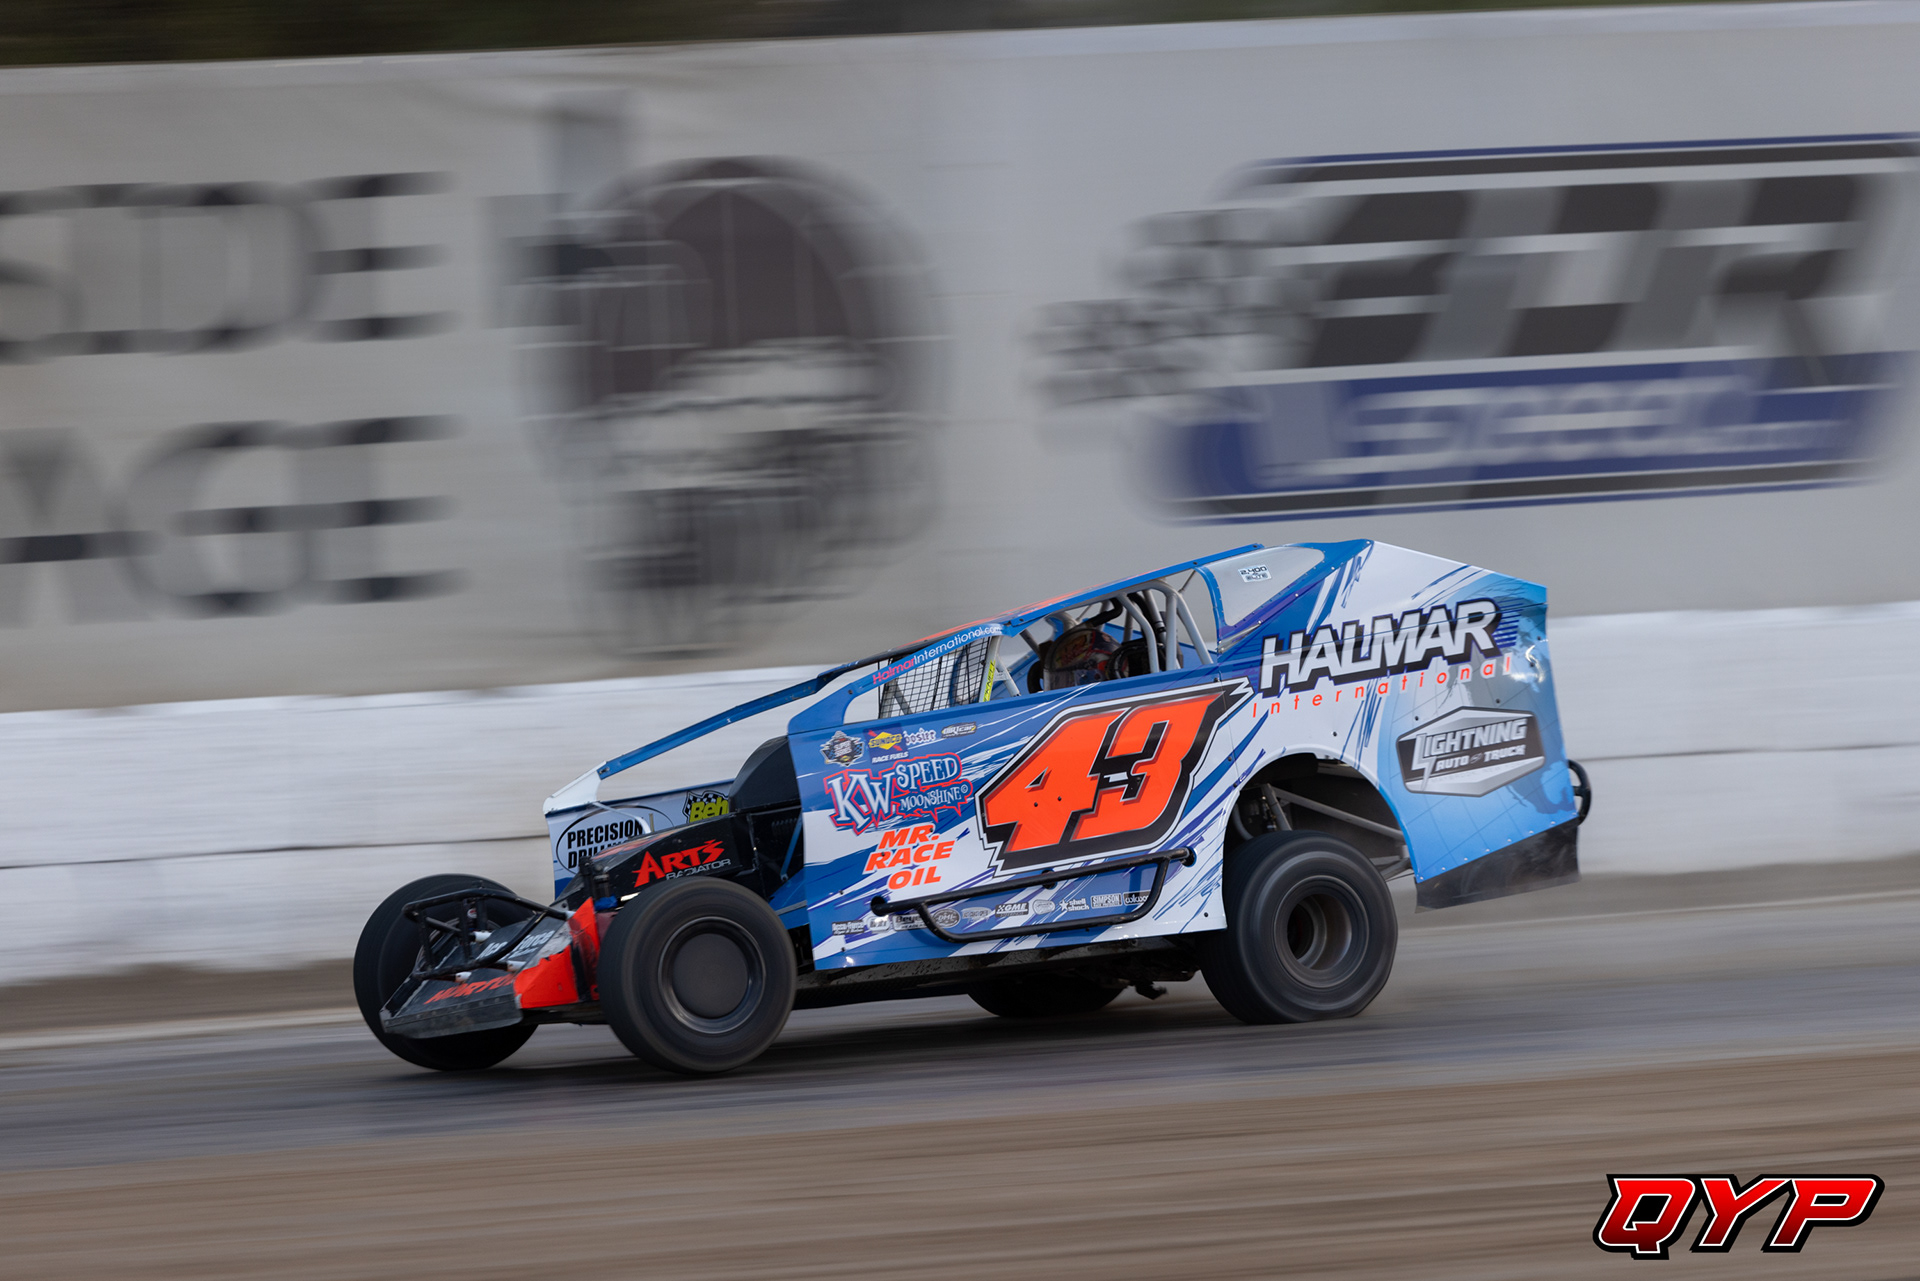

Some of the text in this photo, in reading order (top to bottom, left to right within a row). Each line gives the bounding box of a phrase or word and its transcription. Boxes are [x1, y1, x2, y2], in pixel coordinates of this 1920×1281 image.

[1258, 598, 1502, 698] HALMAR
[1252, 656, 1511, 718] International
[869, 733, 903, 747] SUNOCO
[1411, 718, 1528, 776] LIGHTNING
[872, 751, 908, 763] RACE FUELS
[982, 688, 1228, 856] 43
[1435, 755, 1470, 772] AUTO
[1483, 744, 1526, 762] TRUCK
[895, 757, 958, 790] SPEED
[827, 771, 896, 829] KW
[567, 819, 643, 849] PRECISION
[878, 824, 940, 850] MR.
[665, 858, 731, 880] RADIATOR
[865, 840, 955, 872] RACE
[888, 866, 941, 890] OIL
